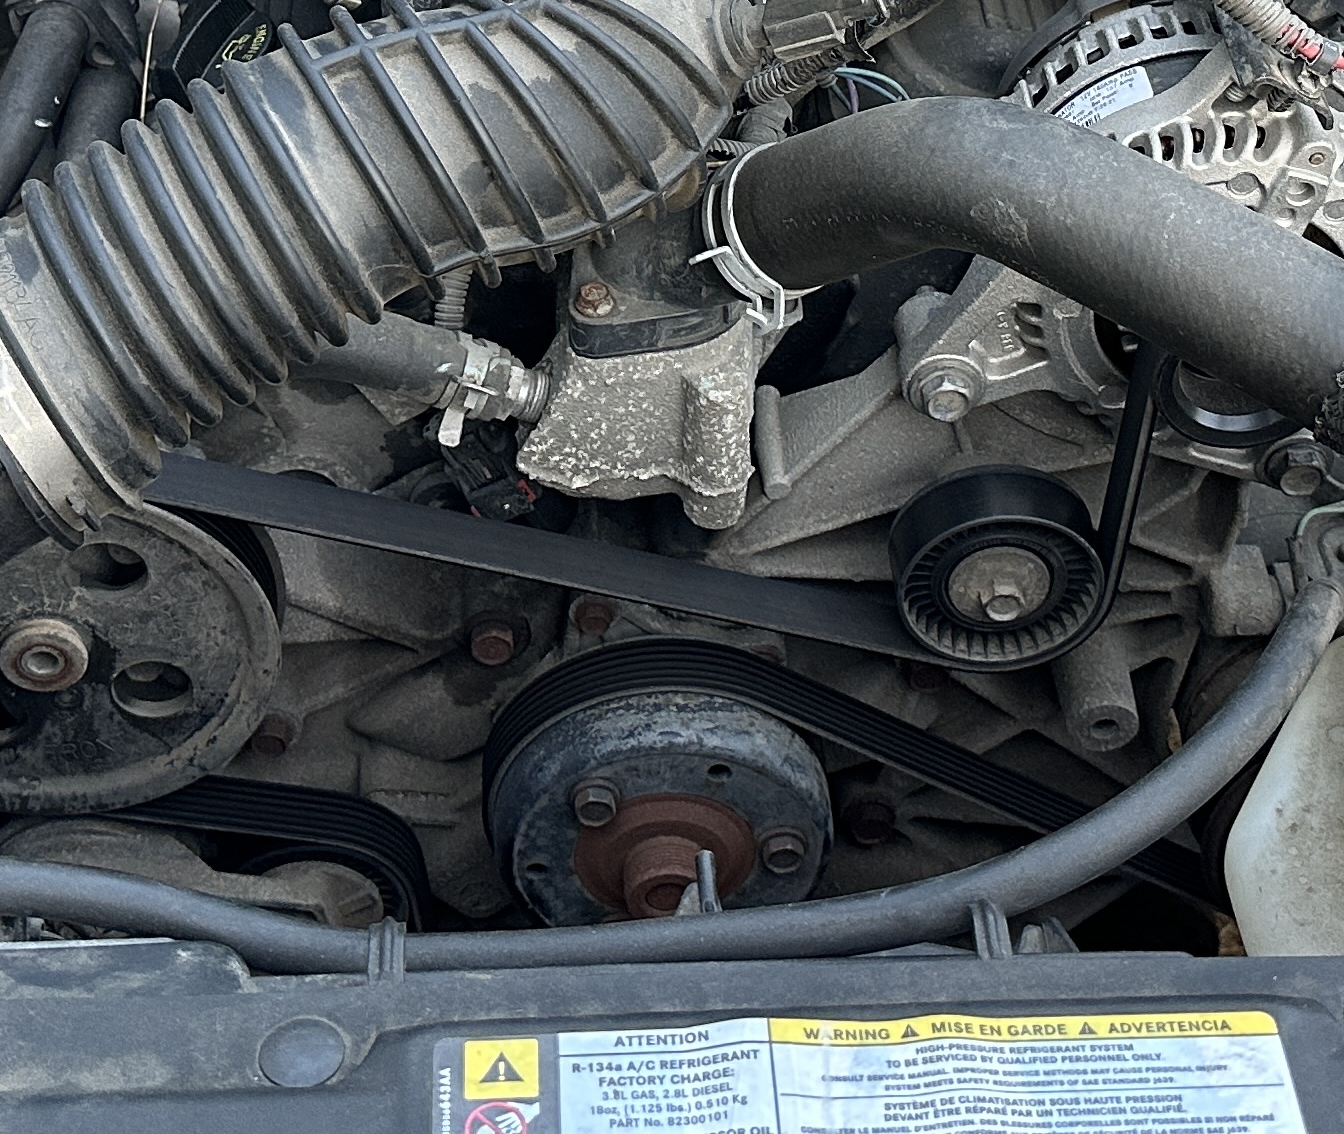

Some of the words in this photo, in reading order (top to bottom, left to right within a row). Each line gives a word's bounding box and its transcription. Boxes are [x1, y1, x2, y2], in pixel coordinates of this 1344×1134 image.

[931, 1021, 975, 1034] MISE
[979, 1024, 1002, 1036] EN
[1007, 1023, 1068, 1036] GARDE
[1108, 1019, 1233, 1034] ADVERTENCIA
[614, 1030, 709, 1048] ATTENTION
[916, 1043, 1006, 1055] HIGH-PRESSURE
[1009, 1044, 1086, 1055] REFRIGERANT
[1089, 1043, 1134, 1053] SYSTEM
[572, 1062, 622, 1073] R-134a
[627, 1060, 656, 1073] A/C
[659, 1049, 760, 1071] REFRIGERANT
[886, 1059, 902, 1069] TO
[904, 1057, 919, 1068] BE
[922, 1054, 977, 1066] SERVICED
[980, 1055, 994, 1064] BY
[997, 1055, 1058, 1065] QUALIFIED
[1061, 1054, 1129, 1064] PERSONNEL
[599, 1074, 666, 1087] FACTORY
[670, 1067, 735, 1084] CHARGE:
[631, 1089, 659, 1102] GAS,
[663, 1088, 688, 1099] 2.8L
[692, 1082, 733, 1097] DIESEL
[590, 1105, 620, 1117] 18oz,
[624, 1103, 663, 1117] (1.125
[695, 1096, 729, 1111] 0.510
[732, 1094, 748, 1105] Kg
[884, 1099, 936, 1111] SYSTÈME
[940, 1096, 955, 1106] DE
[958, 1095, 1045, 1107] CLIMATISATION
[1049, 1097, 1081, 1106] SOUS
[1084, 1095, 1122, 1105] HAUTE
[1125, 1094, 1182, 1104] PRESSION
[609, 1117, 640, 1129] PART
[644, 1117, 664, 1128] No.
[667, 1110, 729, 1127] 82300101
[884, 1111, 929, 1122] DEVANT
[965, 1104, 1008, 1115] RÉPARÉ
[1011, 1108, 1033, 1117] PAR
[1036, 1108, 1053, 1117] UN
[1056, 1106, 1127, 1116] TECHNICIEN
